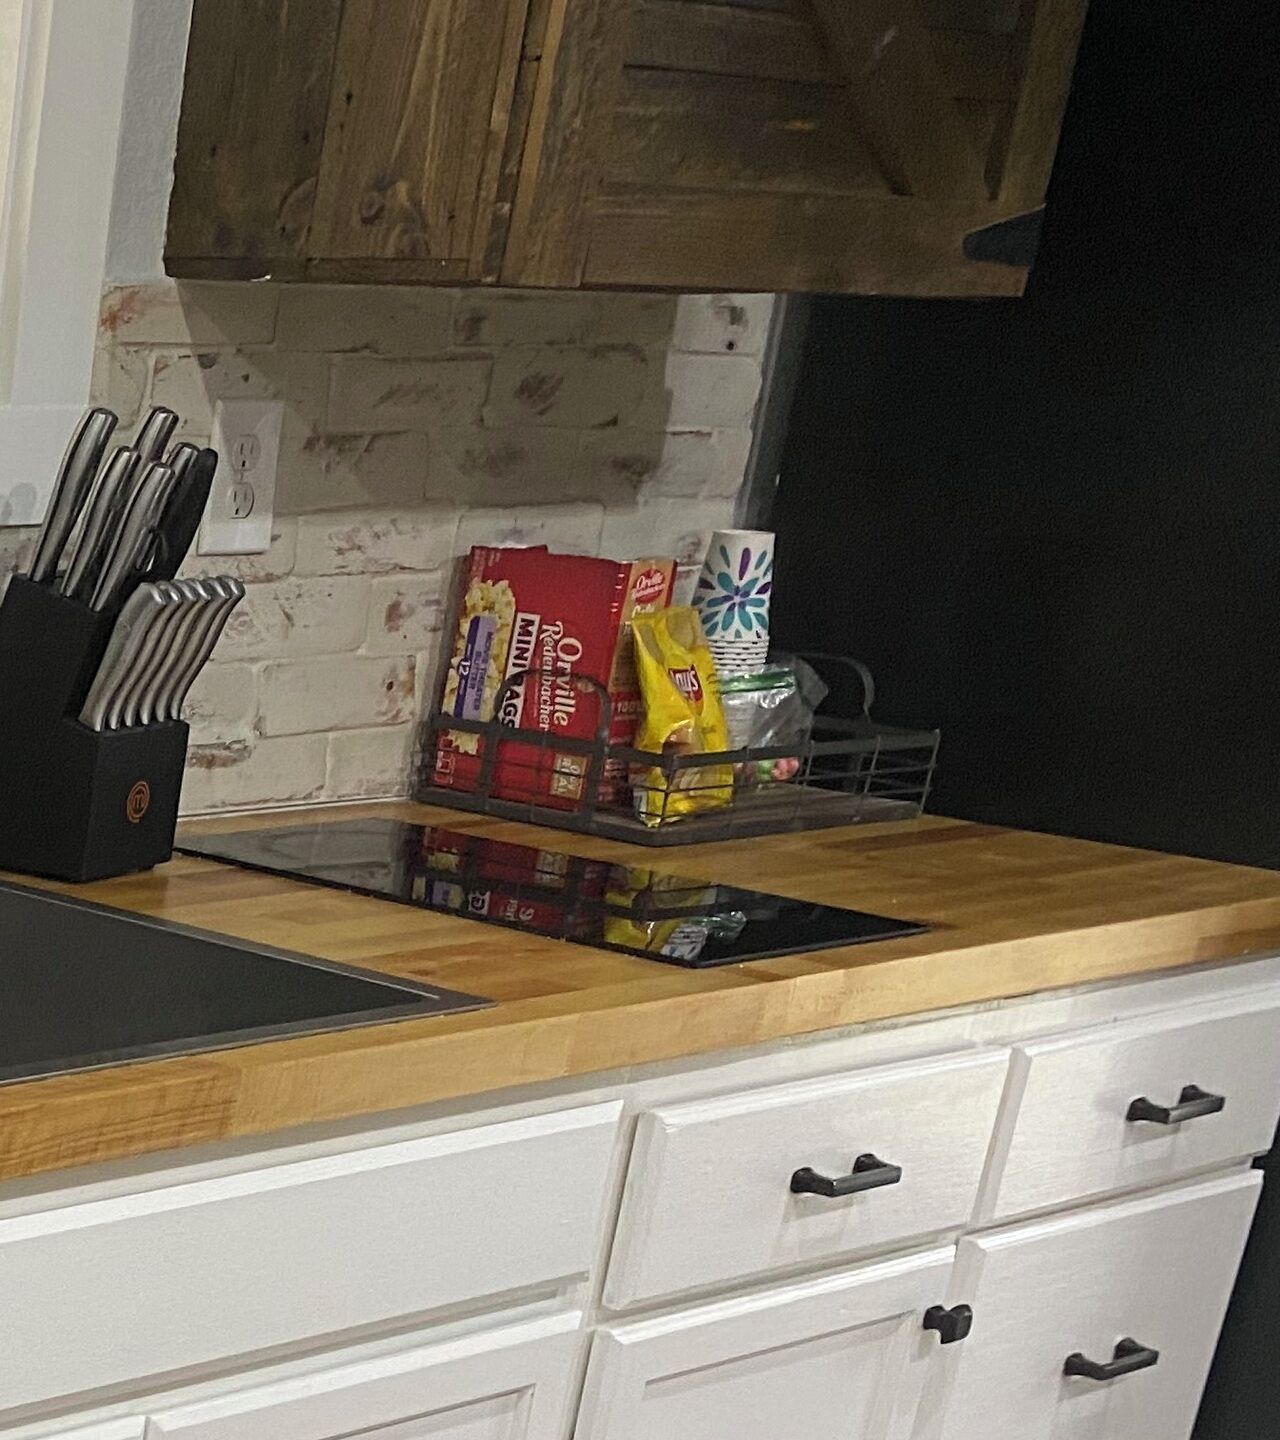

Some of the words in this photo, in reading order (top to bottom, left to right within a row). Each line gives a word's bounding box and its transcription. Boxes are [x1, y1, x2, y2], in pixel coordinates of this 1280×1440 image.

[459, 660, 471, 675] 12
[512, 617, 535, 669] MINI
[539, 620, 564, 732] Redenbacher
[554, 637, 583, 726] Orville
